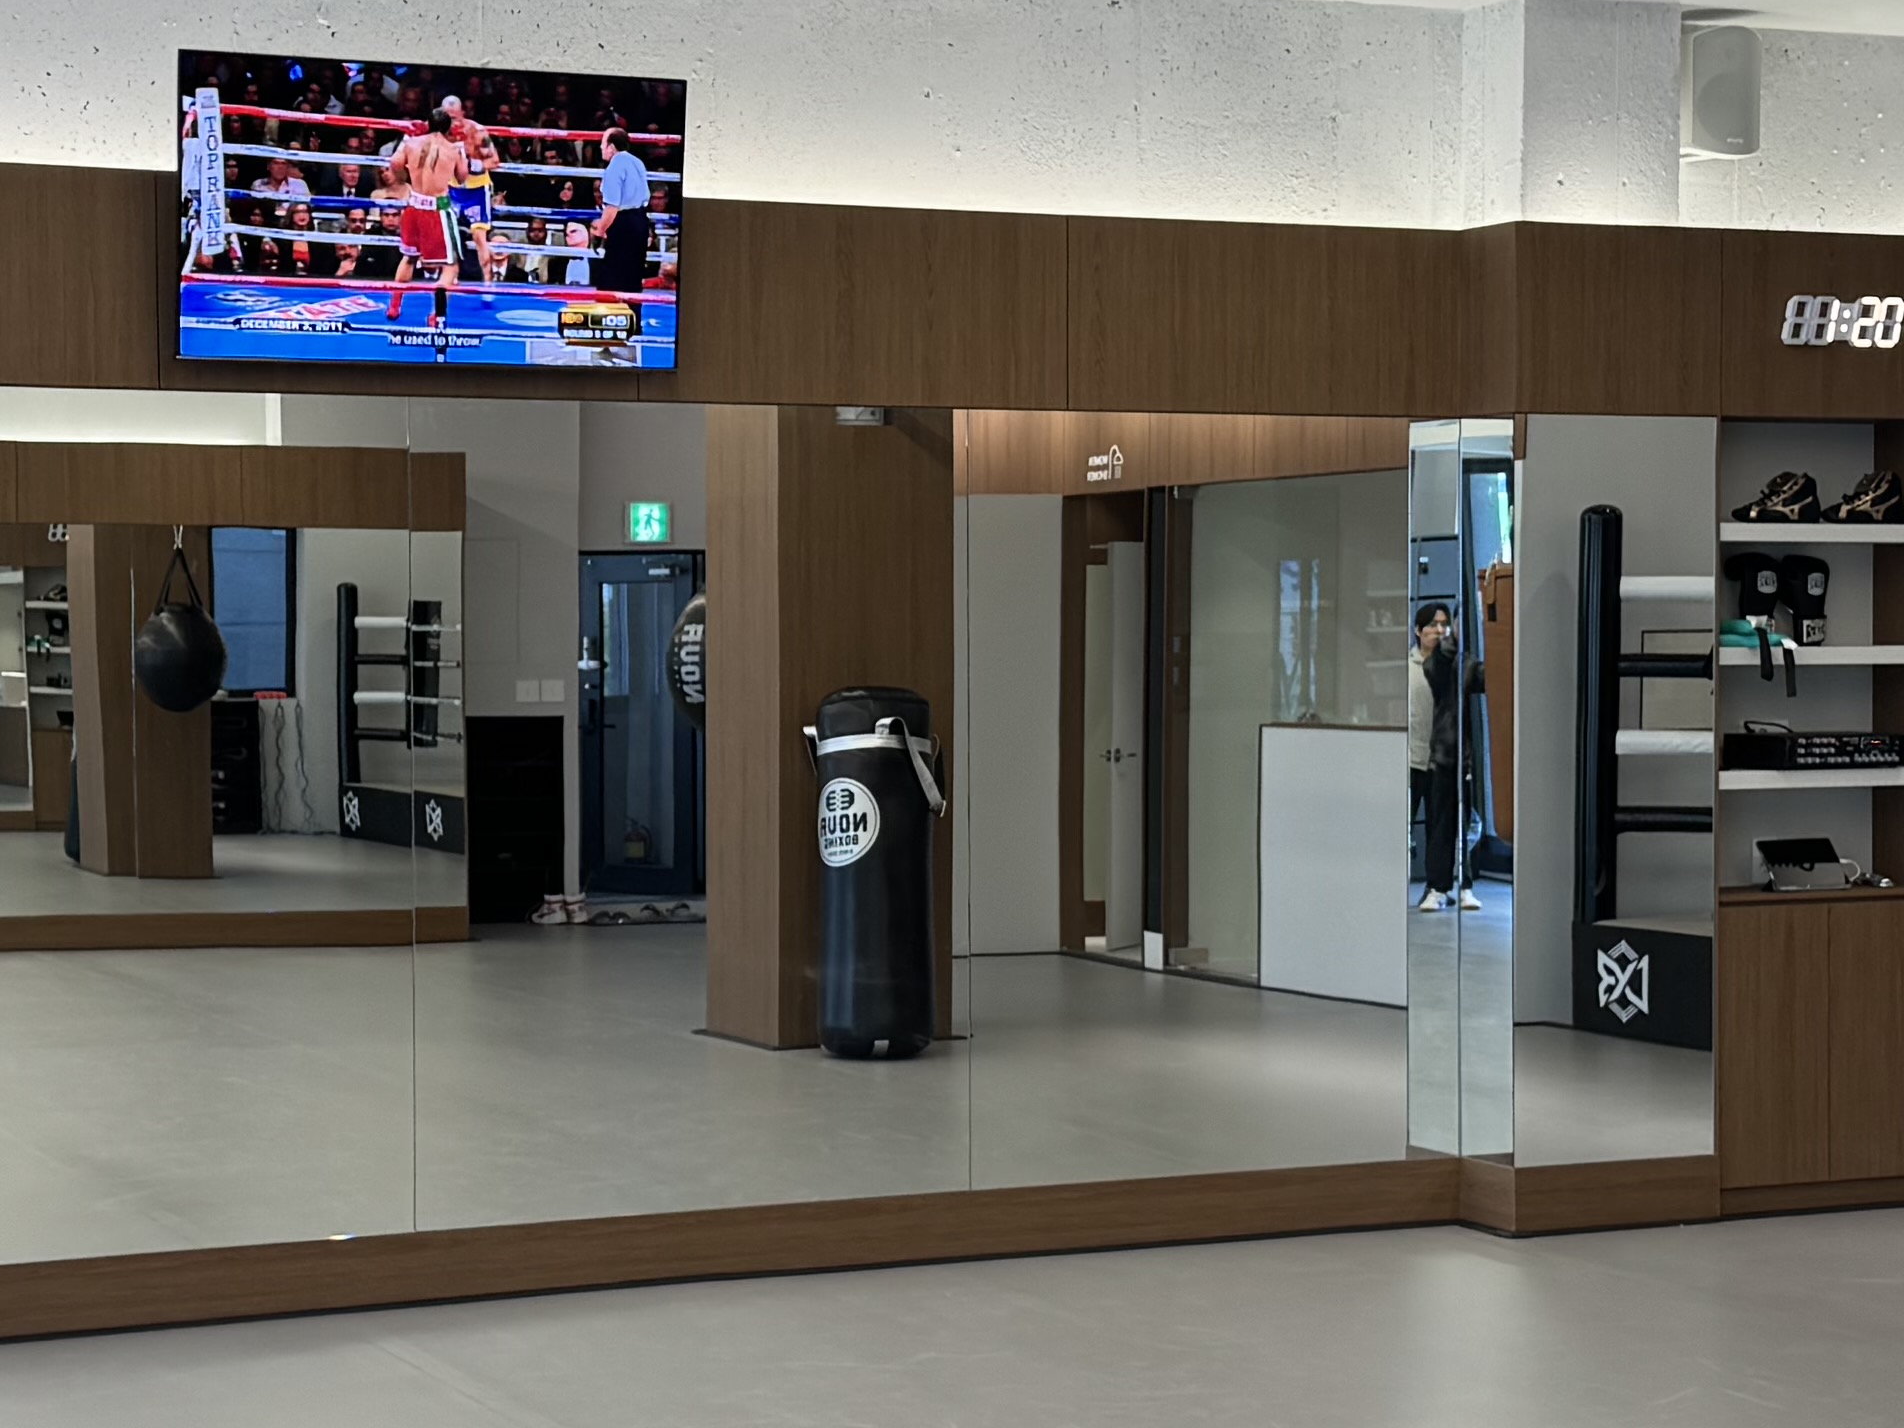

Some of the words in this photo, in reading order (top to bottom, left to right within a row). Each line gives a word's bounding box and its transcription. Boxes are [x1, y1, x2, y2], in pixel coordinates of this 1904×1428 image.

[205, 116, 219, 170] TOP
[404, 334, 432, 345] used
[434, 335, 446, 346] to
